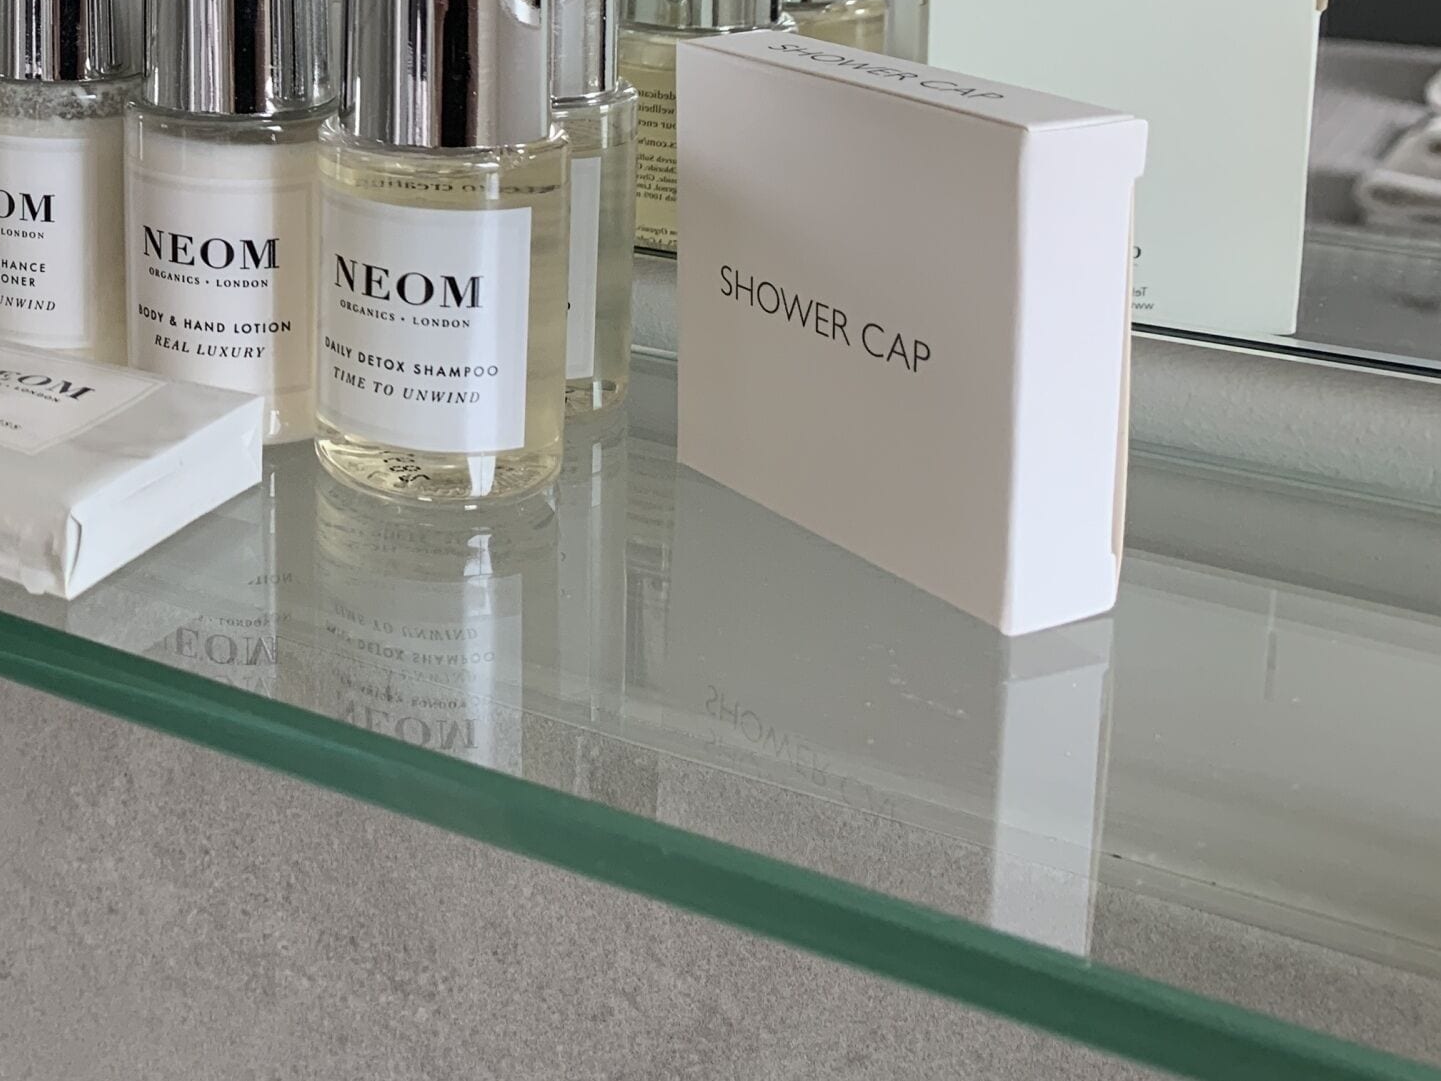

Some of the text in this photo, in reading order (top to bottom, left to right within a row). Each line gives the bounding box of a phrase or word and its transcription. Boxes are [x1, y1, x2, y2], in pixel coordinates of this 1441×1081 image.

[768, 43, 1004, 101] SHOWER CAP
[0, 227, 45, 239] LONDON
[143, 224, 281, 270] NEOM
[148, 266, 269, 288] ORGANICS LONDON
[334, 253, 484, 309] NEOM
[138, 303, 292, 334] BODY & HAND LOTION
[340, 299, 471, 328] ORGANICS LONDON
[720, 265, 931, 373] SHOWER CAP
[154, 334, 266, 358] REAL LUXURY
[324, 336, 499, 378] DAILY DETOX SHAMPOO
[333, 366, 481, 404] TIME TO UNWIND
